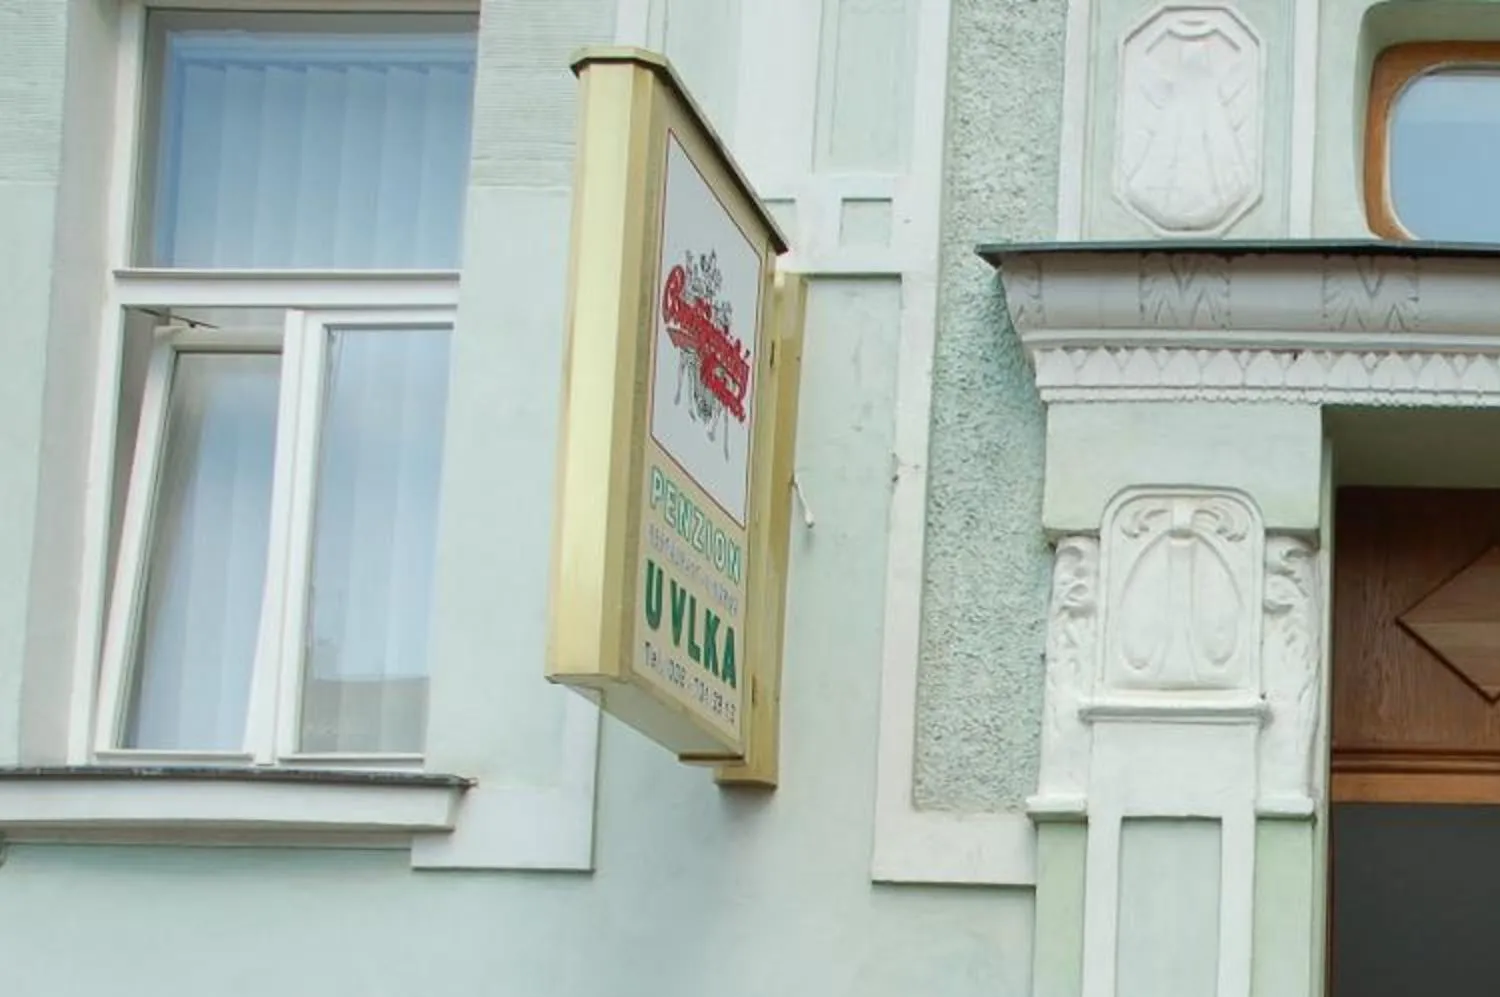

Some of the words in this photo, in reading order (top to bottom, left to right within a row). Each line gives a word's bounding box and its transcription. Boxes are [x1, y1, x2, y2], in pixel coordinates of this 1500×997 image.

[651, 465, 741, 588] PENZION
[645, 558, 664, 632] U
[670, 578, 737, 690] VLKA
